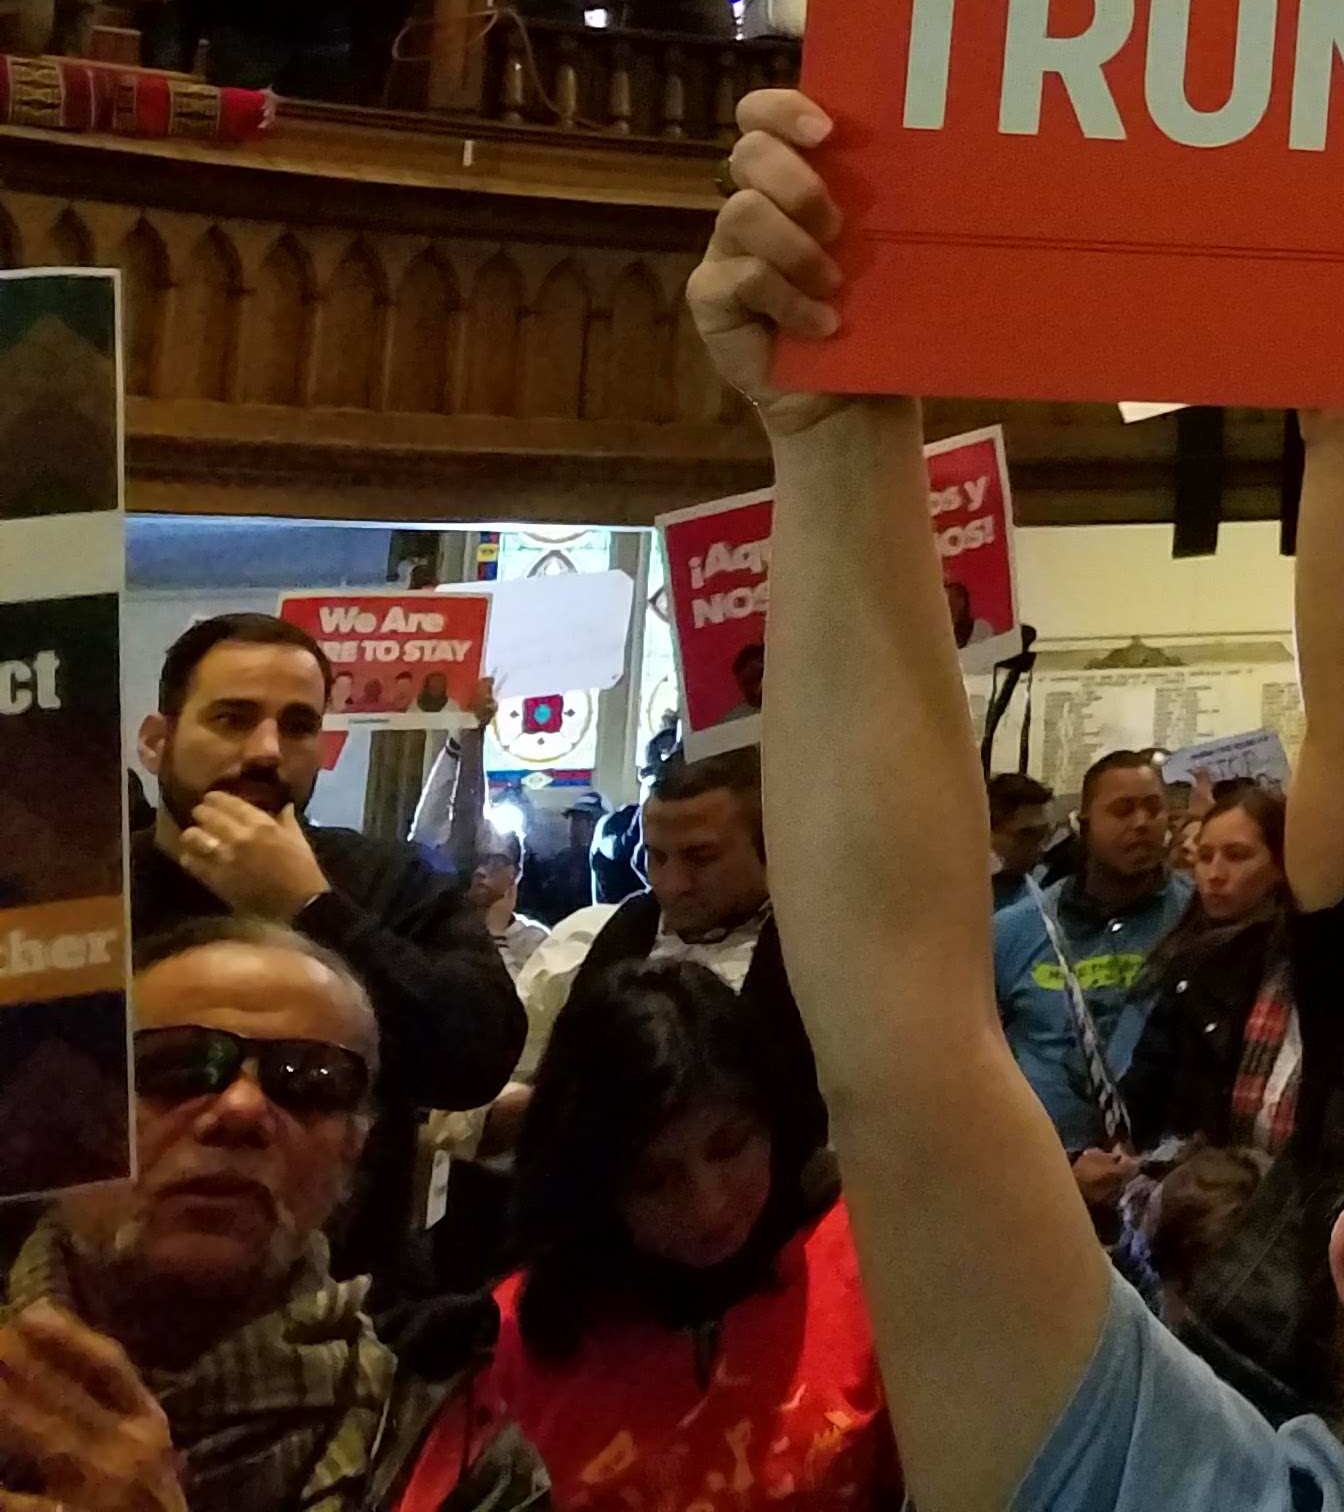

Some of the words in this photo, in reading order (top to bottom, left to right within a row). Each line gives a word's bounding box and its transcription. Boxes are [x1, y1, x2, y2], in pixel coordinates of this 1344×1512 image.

[318, 605, 378, 635] We
[379, 605, 446, 634] Are
[360, 639, 400, 663] TO
[402, 639, 473, 663] STAY
